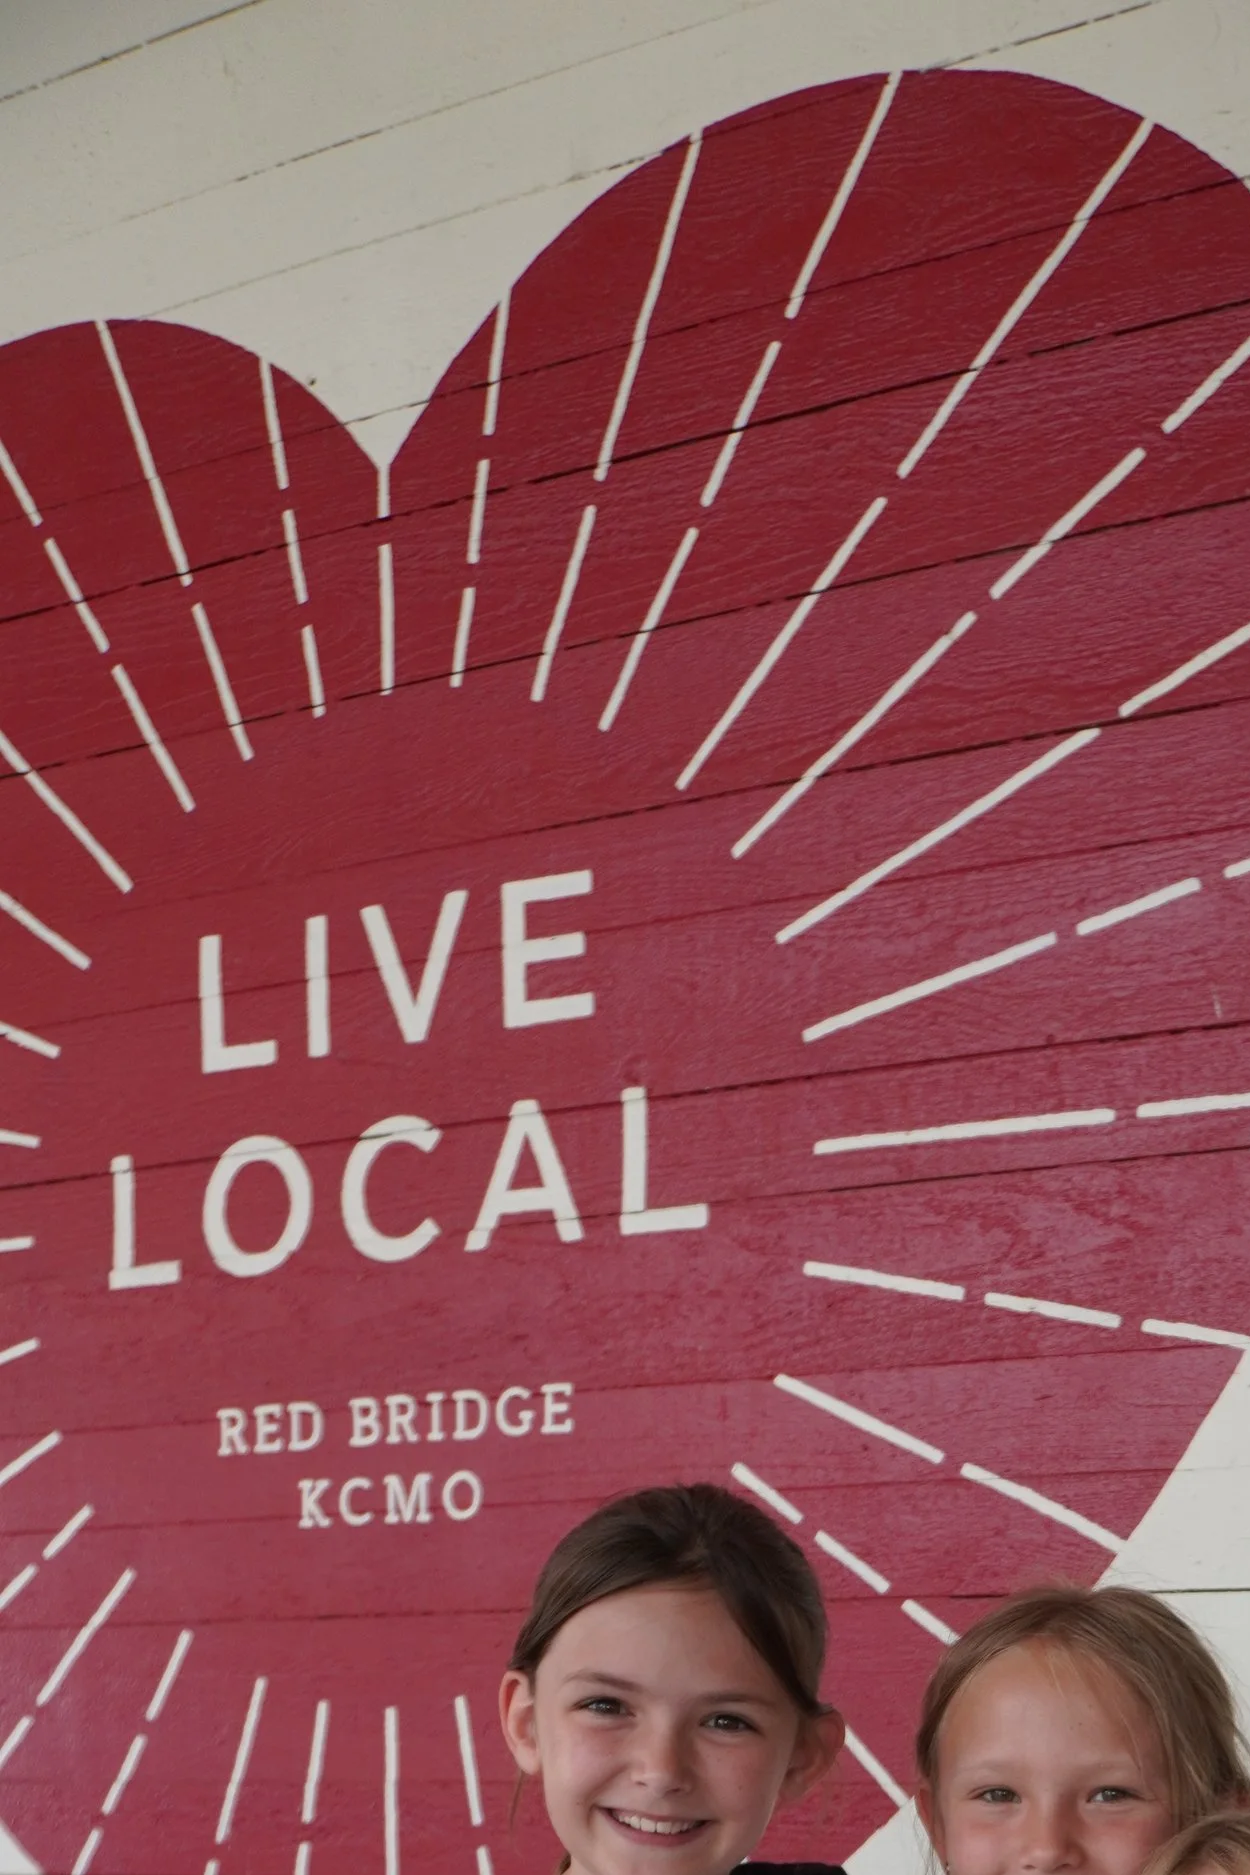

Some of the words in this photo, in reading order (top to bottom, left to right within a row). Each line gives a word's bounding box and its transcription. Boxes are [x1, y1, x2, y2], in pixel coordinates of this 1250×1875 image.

[200, 869, 594, 1074] LIVE
[108, 1086, 709, 1291] LOCAL
[216, 1402, 324, 1457] RED
[348, 1382, 575, 1447] BRIDGE
[298, 1470, 484, 1529] KCMO
